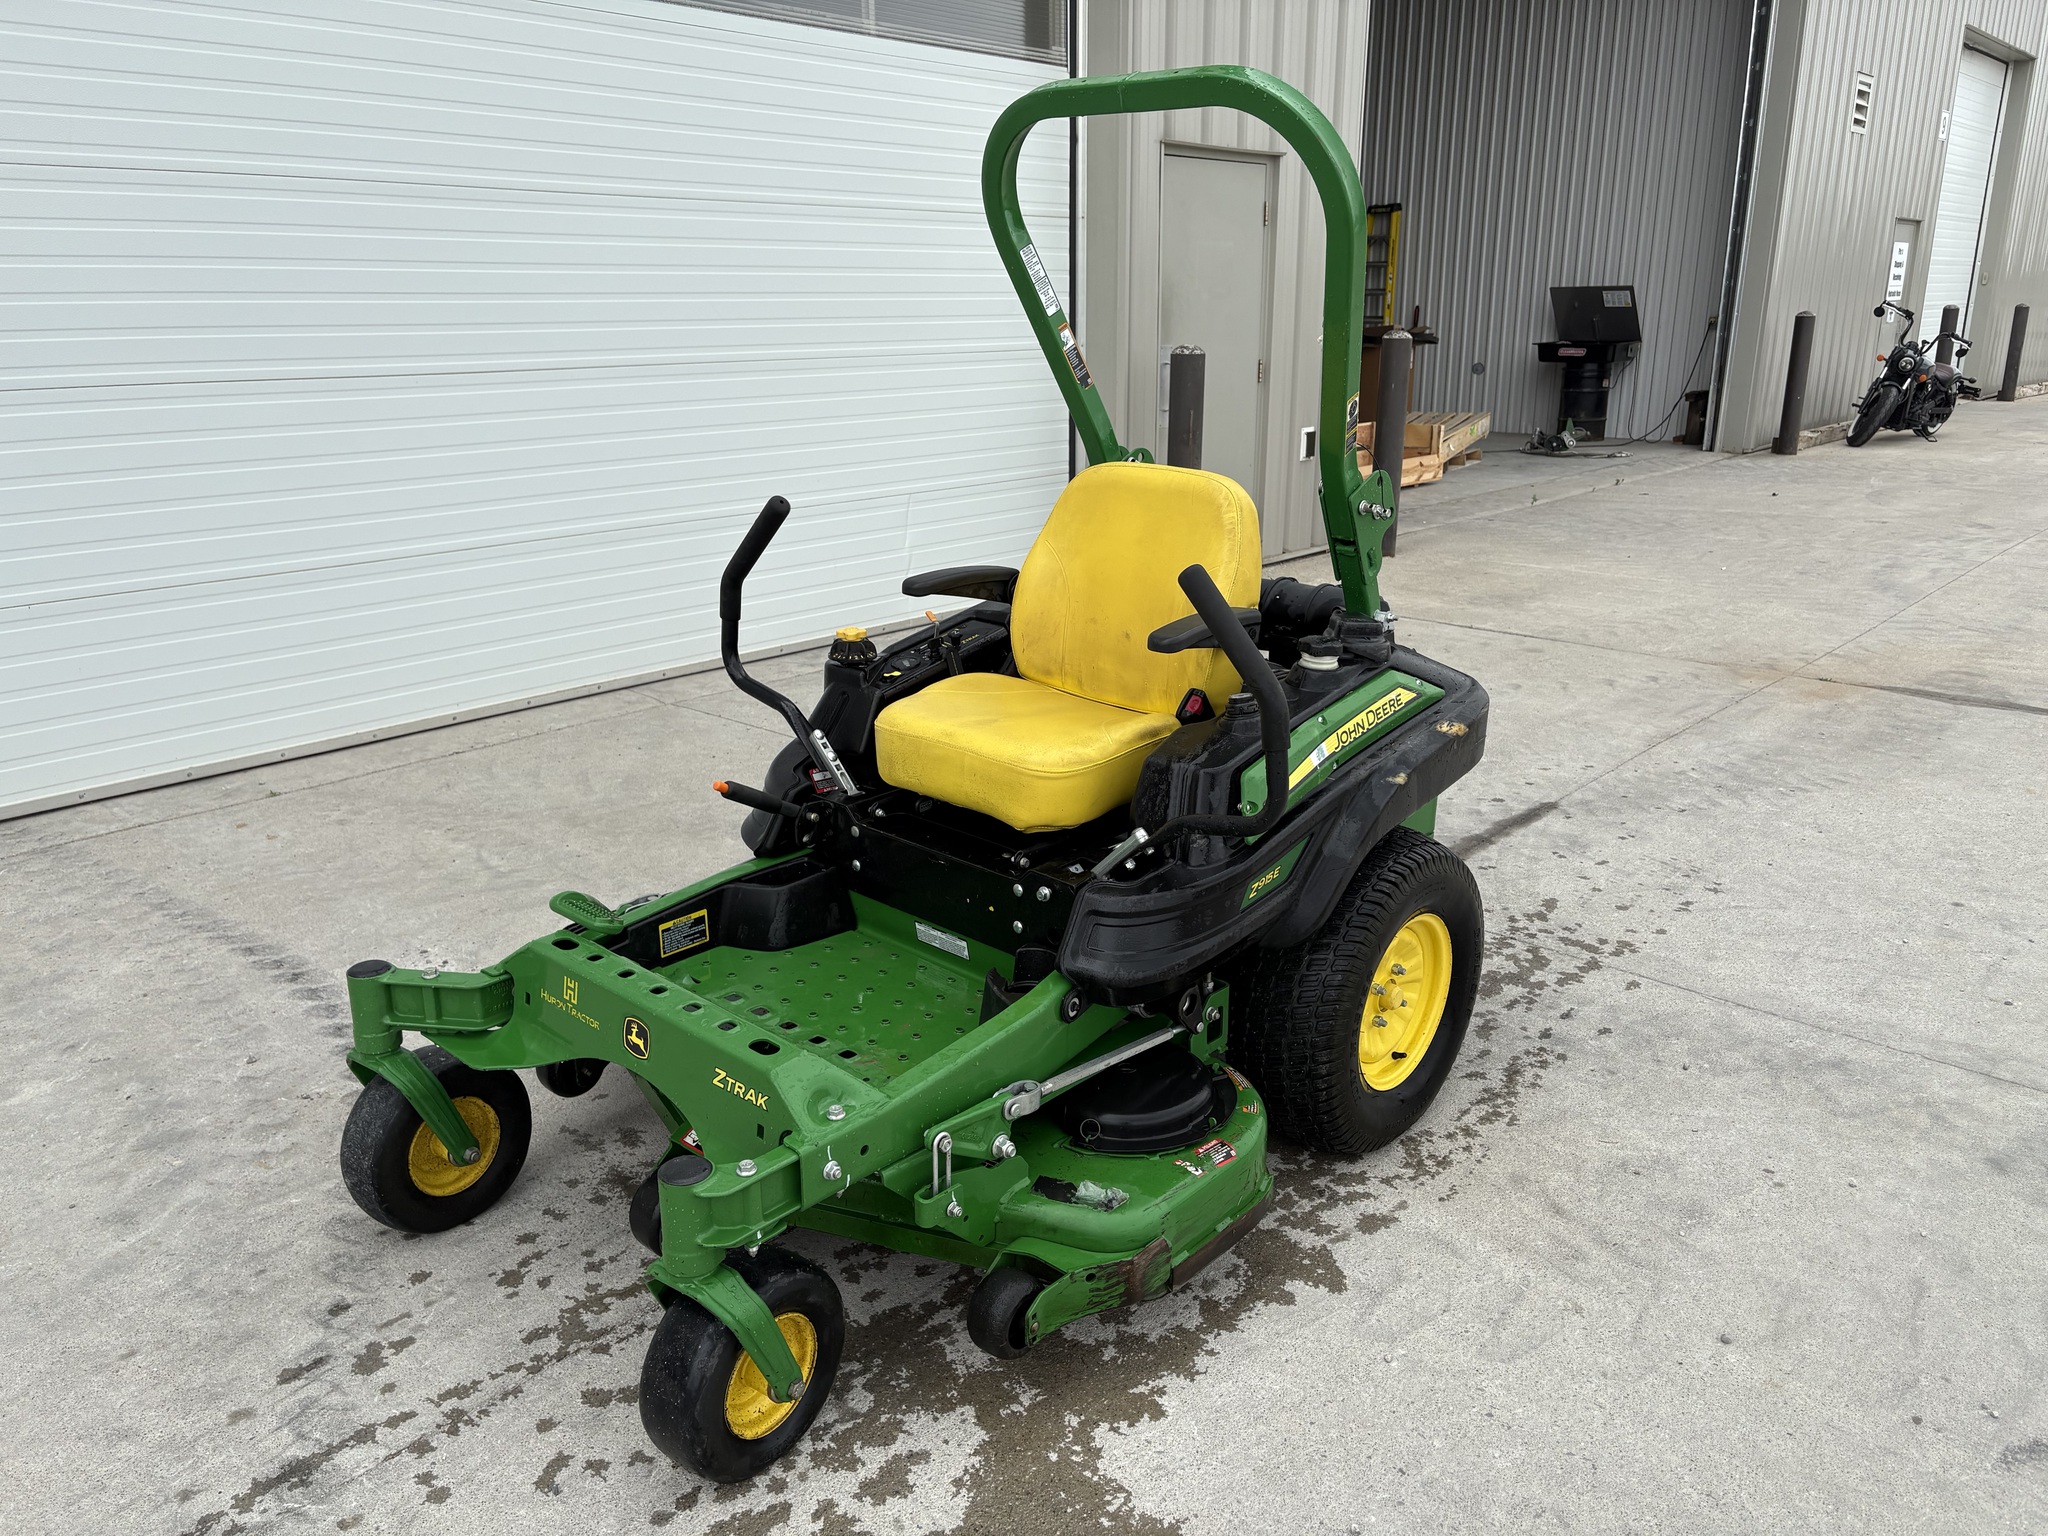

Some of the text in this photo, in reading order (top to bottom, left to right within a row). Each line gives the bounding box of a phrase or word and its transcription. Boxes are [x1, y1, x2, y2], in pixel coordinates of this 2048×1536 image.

[1334, 692, 1404, 751] JOHN DEERE
[1248, 865, 1281, 899] Z915E
[566, 1002, 600, 1031] TRACTOR
[712, 1066, 770, 1111] ZTRAK
